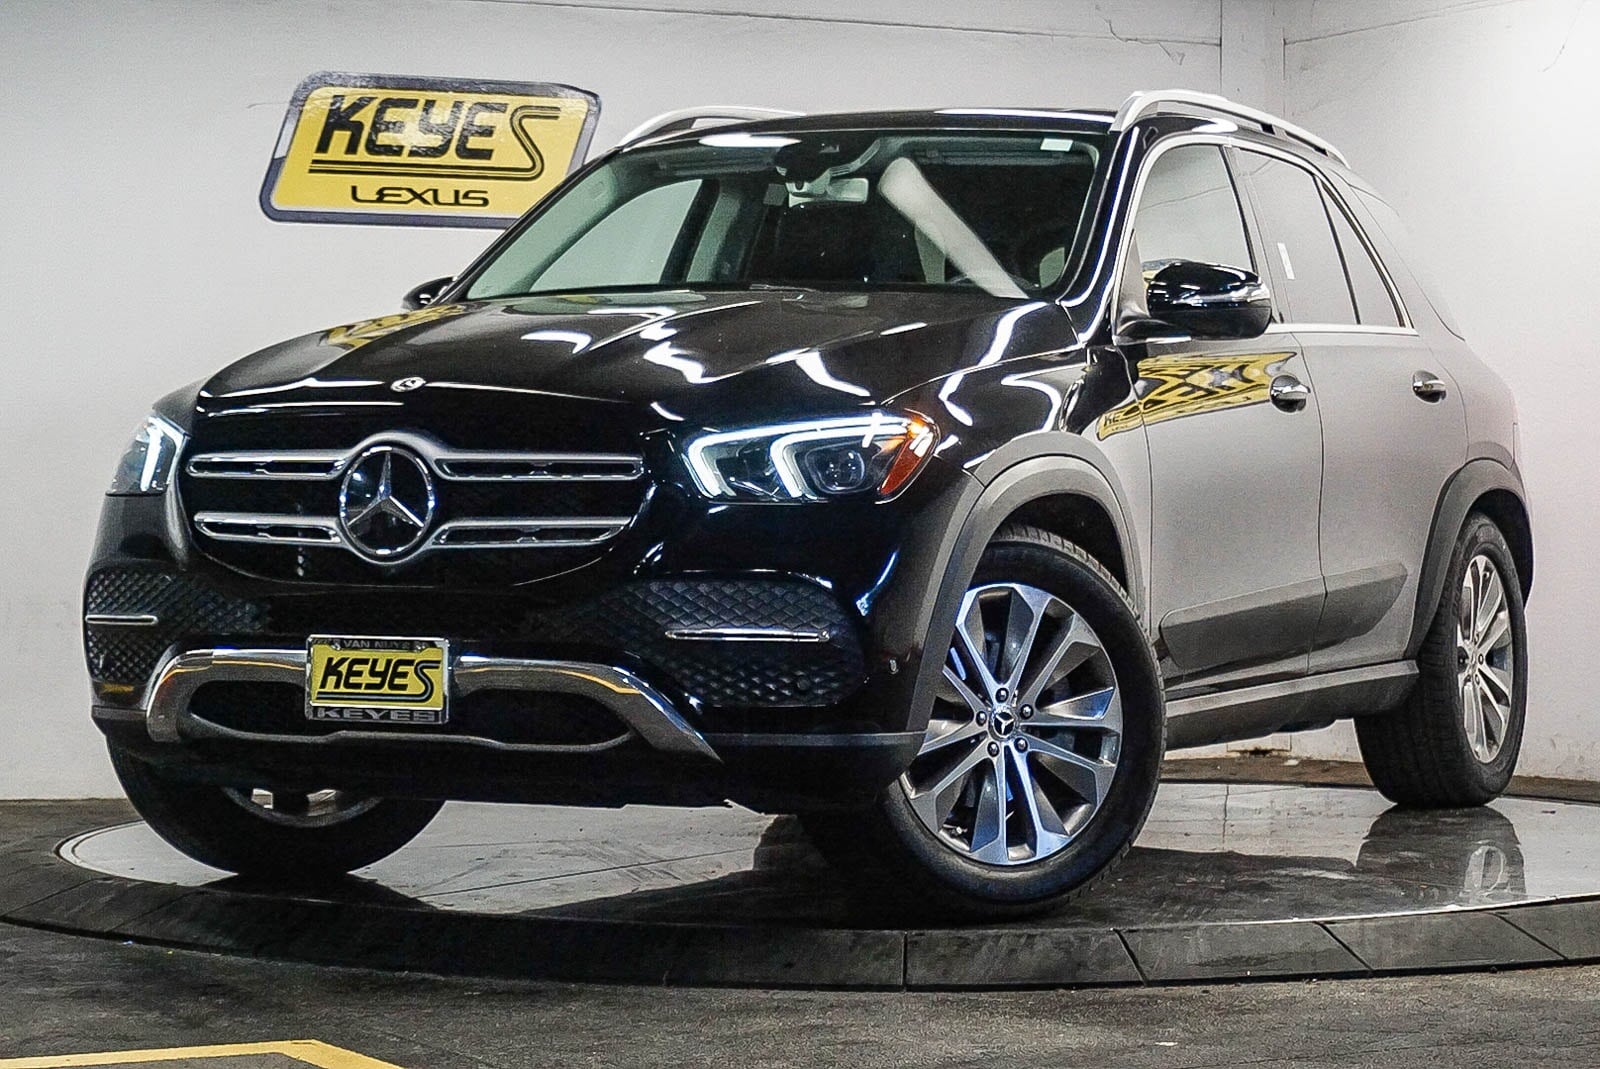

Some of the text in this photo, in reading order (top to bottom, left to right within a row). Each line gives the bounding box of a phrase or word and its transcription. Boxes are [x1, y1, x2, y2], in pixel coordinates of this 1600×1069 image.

[308, 94, 561, 181] KEYES
[351, 185, 490, 207] LEXUS
[343, 639, 371, 649] VAN
[316, 656, 441, 703] KEYES
[317, 707, 436, 722] KEYES
